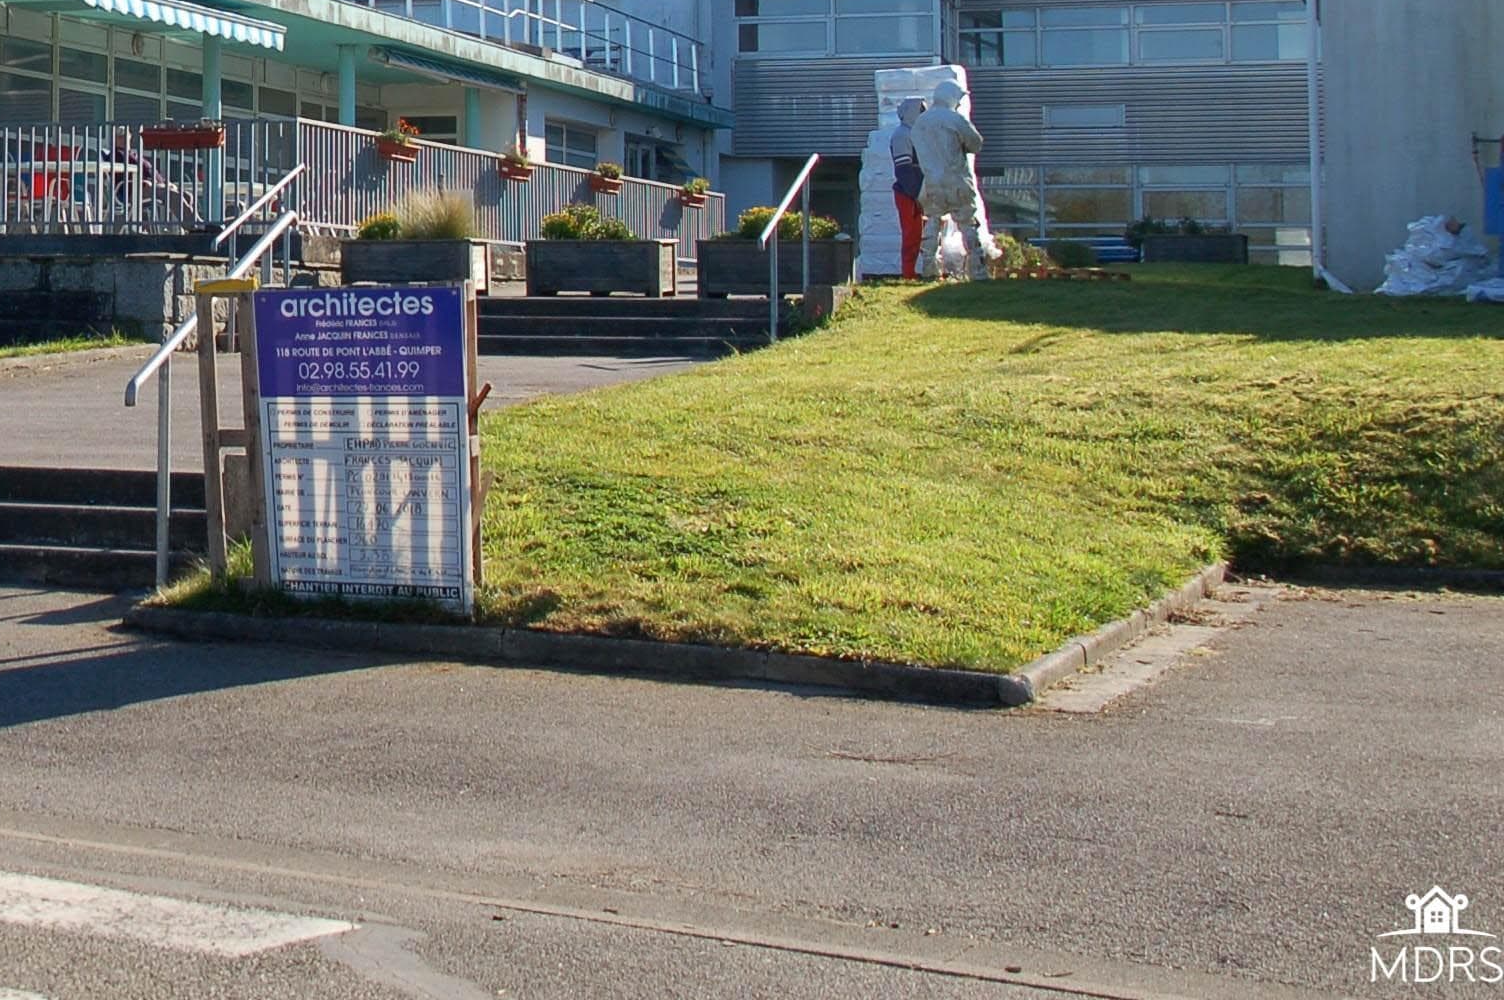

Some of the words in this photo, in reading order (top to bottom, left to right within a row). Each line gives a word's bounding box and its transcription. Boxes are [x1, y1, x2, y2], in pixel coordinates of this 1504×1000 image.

[280, 291, 434, 318] architectes
[345, 319, 377, 327] FRANCES
[295, 333, 315, 341] Anne
[317, 332, 351, 341] JACQUIN
[353, 331, 388, 340] FRANCES
[292, 347, 320, 357] ROUTE
[322, 347, 334, 356] DE
[336, 346, 361, 356] PONT
[362, 344, 392, 356] L'ABBÉ
[398, 346, 442, 356] QUIMPER
[298, 361, 420, 380] 02.98.55.41.99
[282, 581, 338, 593] CHANTIER
[341, 583, 394, 595] INTERDIT
[396, 585, 413, 596] AU
[416, 587, 459, 598] PUBLIC
